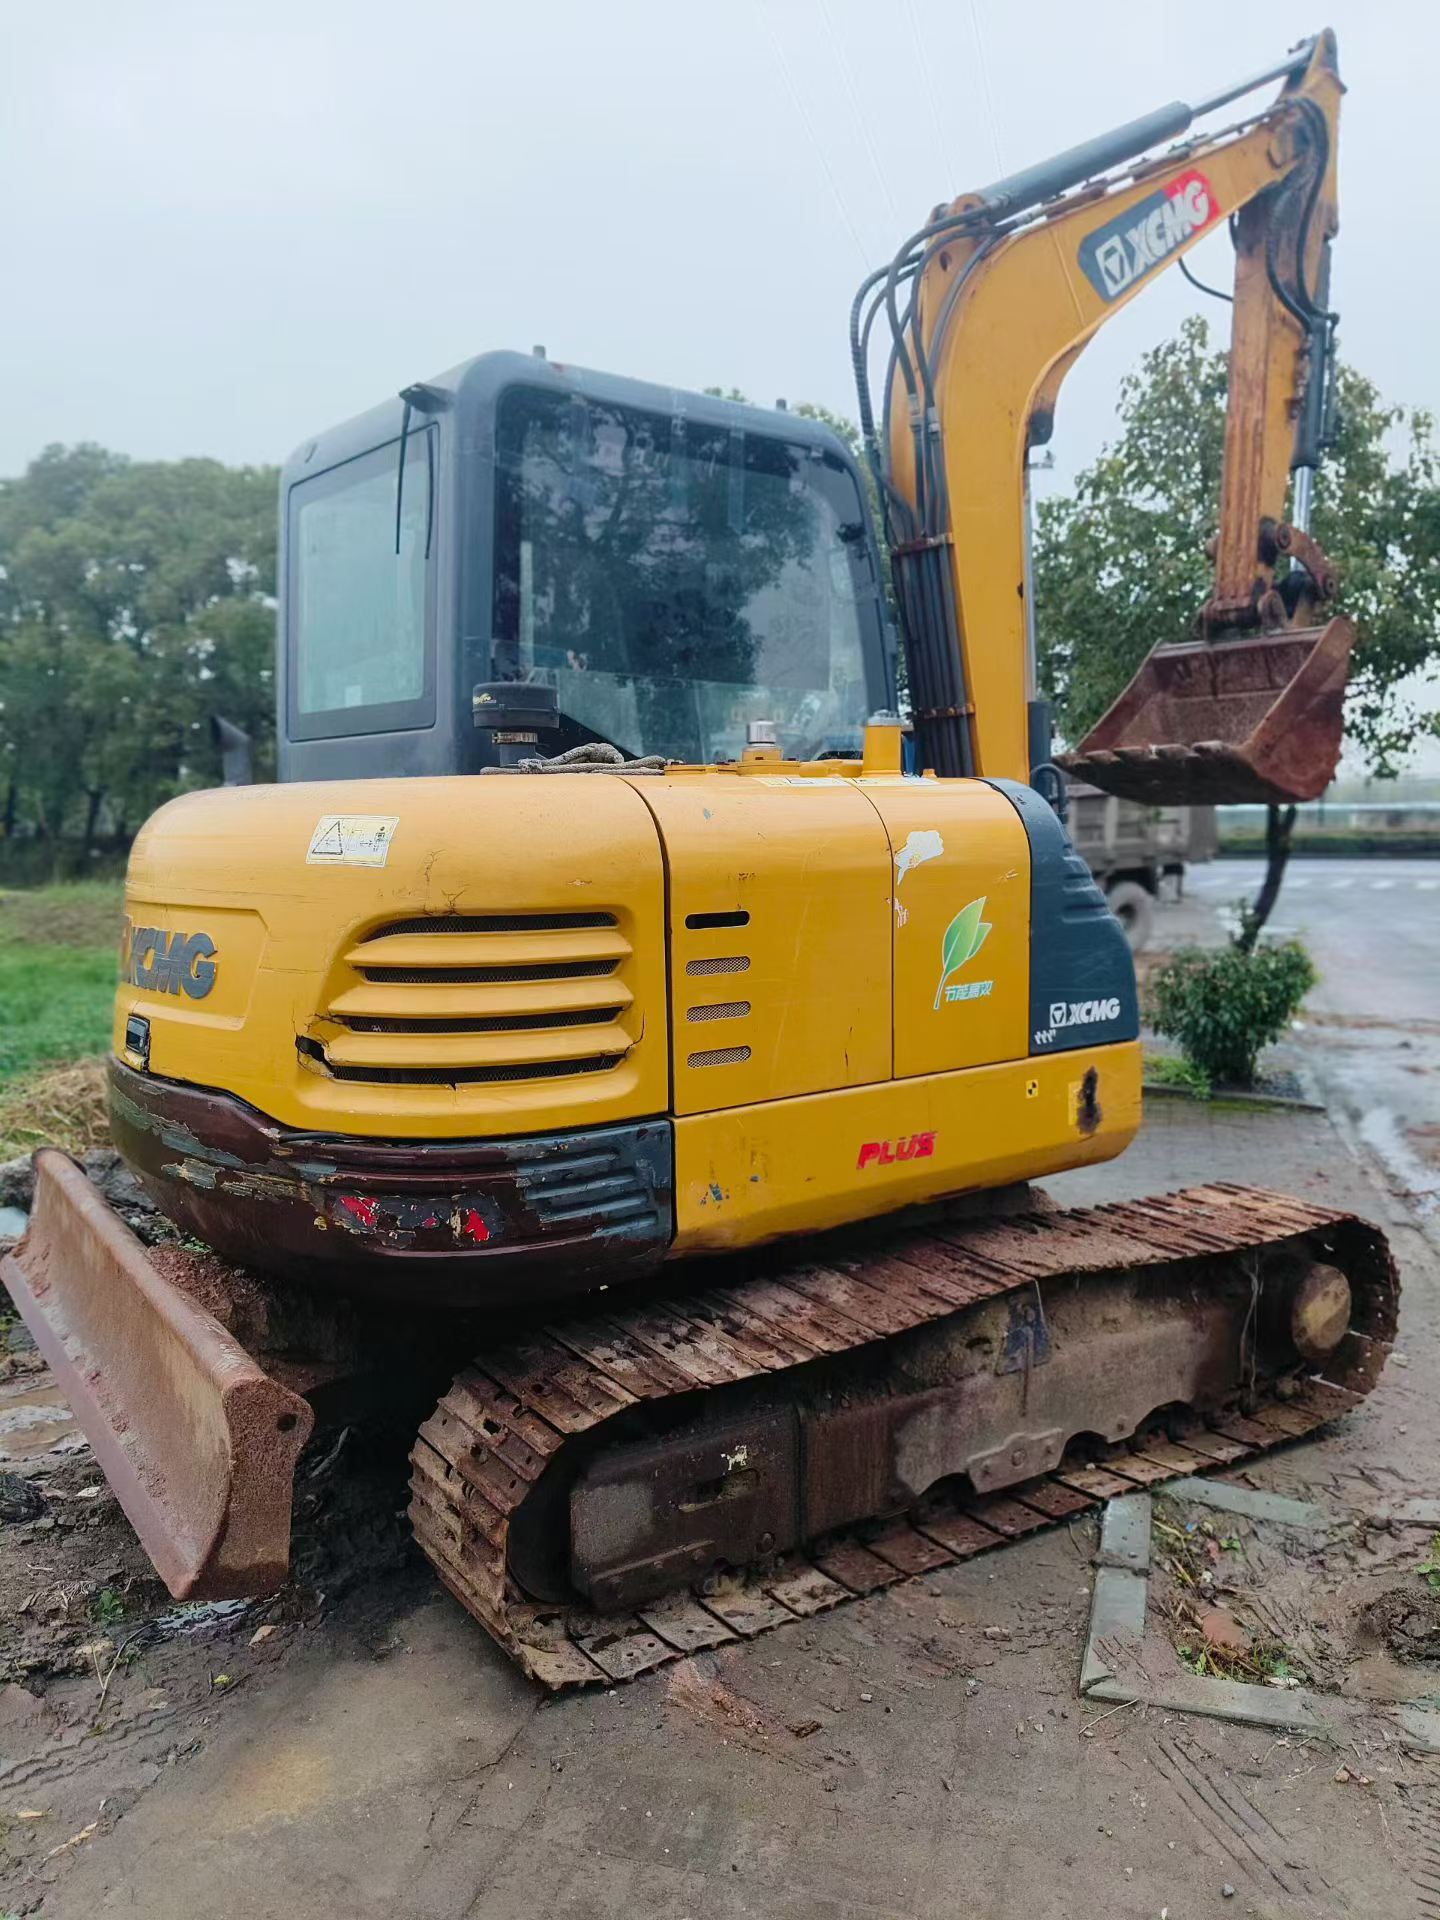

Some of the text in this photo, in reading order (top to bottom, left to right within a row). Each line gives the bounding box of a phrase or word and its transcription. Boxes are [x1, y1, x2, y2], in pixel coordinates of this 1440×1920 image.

[1125, 180, 1209, 275] XCMG
[945, 981, 993, 1002] 节能高效
[1066, 997, 1121, 1026] XCMG
[856, 1131, 938, 1169] PLUS
